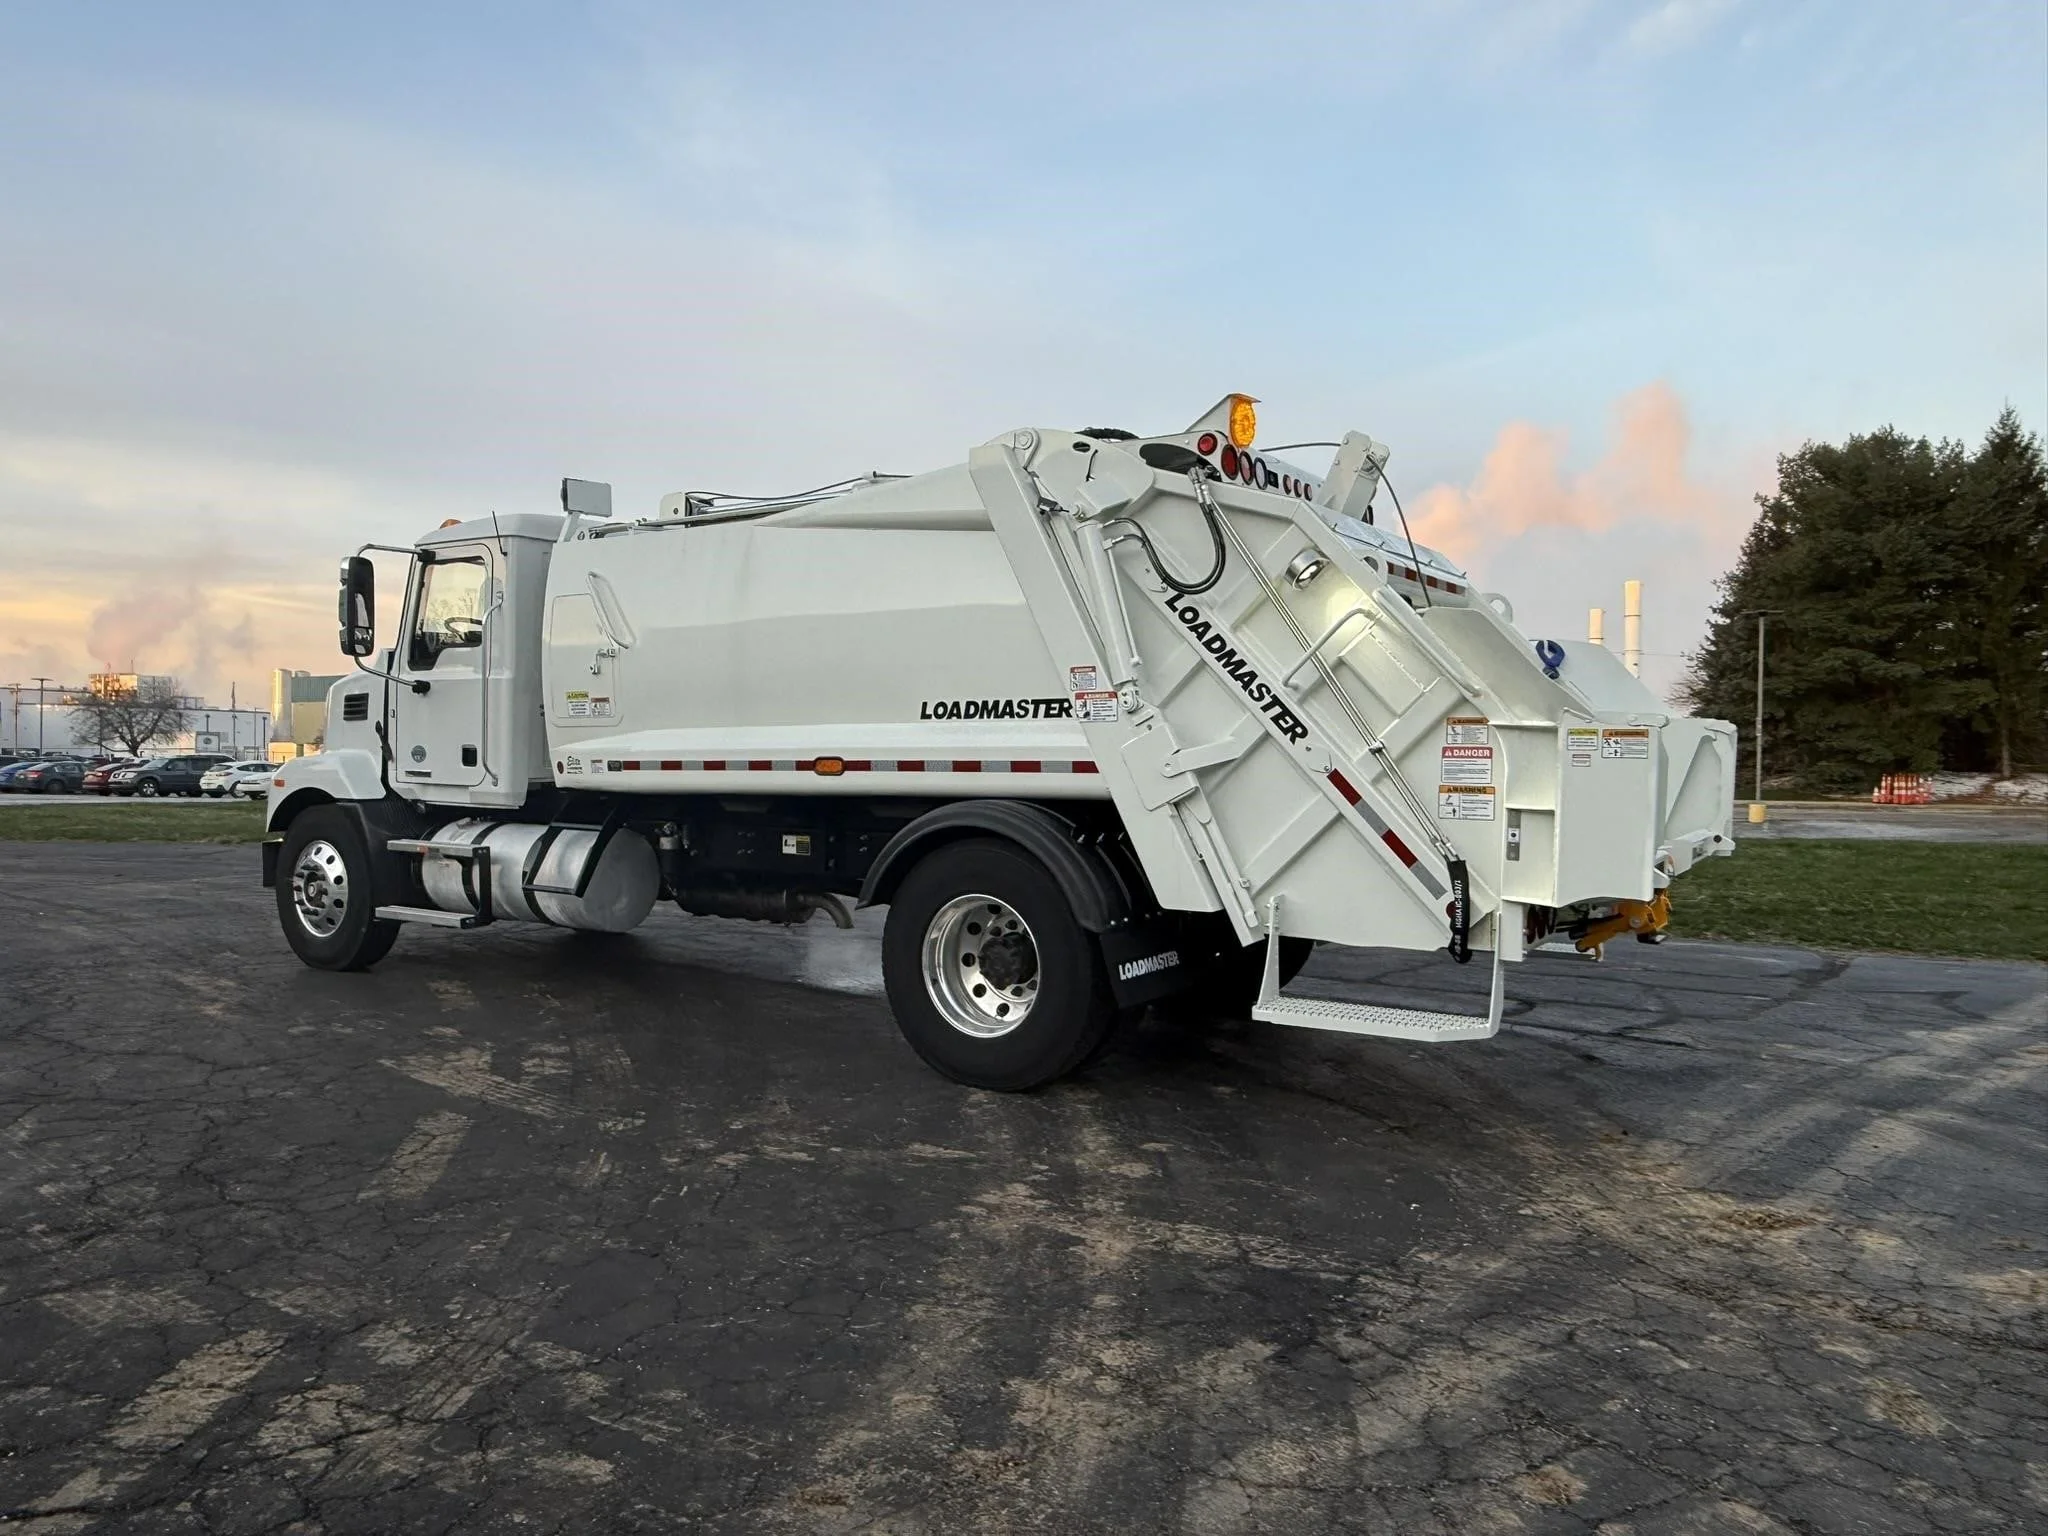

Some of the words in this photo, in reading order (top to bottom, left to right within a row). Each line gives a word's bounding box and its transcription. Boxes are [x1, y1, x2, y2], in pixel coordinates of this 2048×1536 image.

[1164, 593, 1309, 746] LOADMASTER
[920, 698, 1074, 720] LOADMASTER
[1453, 749, 1490, 757] DANGER
[1118, 951, 1180, 981] LOADMASTER
